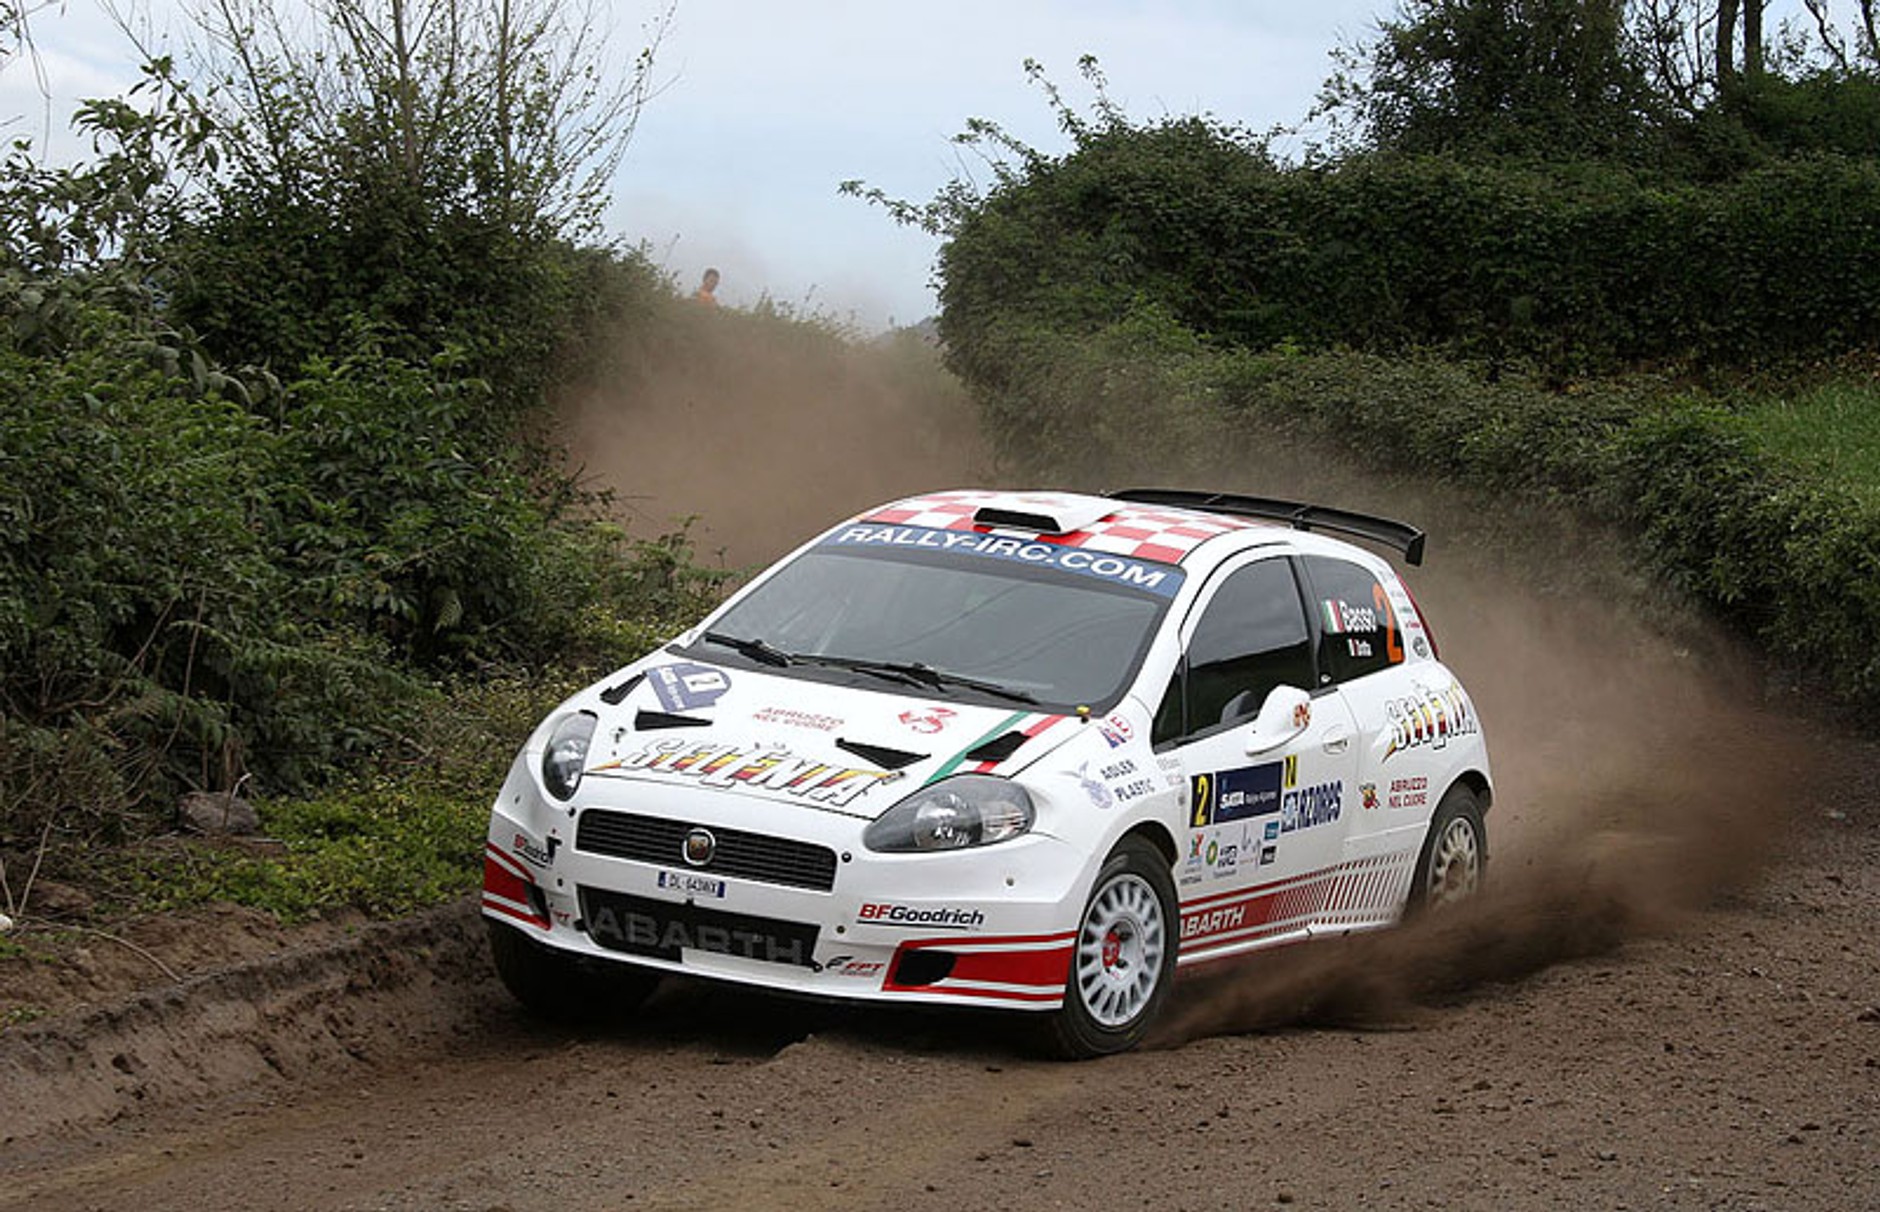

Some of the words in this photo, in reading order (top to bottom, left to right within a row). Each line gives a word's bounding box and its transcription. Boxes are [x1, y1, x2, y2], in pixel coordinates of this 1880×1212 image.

[838, 527, 1167, 588] RALLY-IRC.COM
[1372, 582, 1406, 663] 2
[1114, 778, 1155, 802] PLASTIC
[1194, 775, 1209, 827] 2
[594, 906, 802, 965] ABARTH
[858, 903, 984, 925] BFGoodrich
